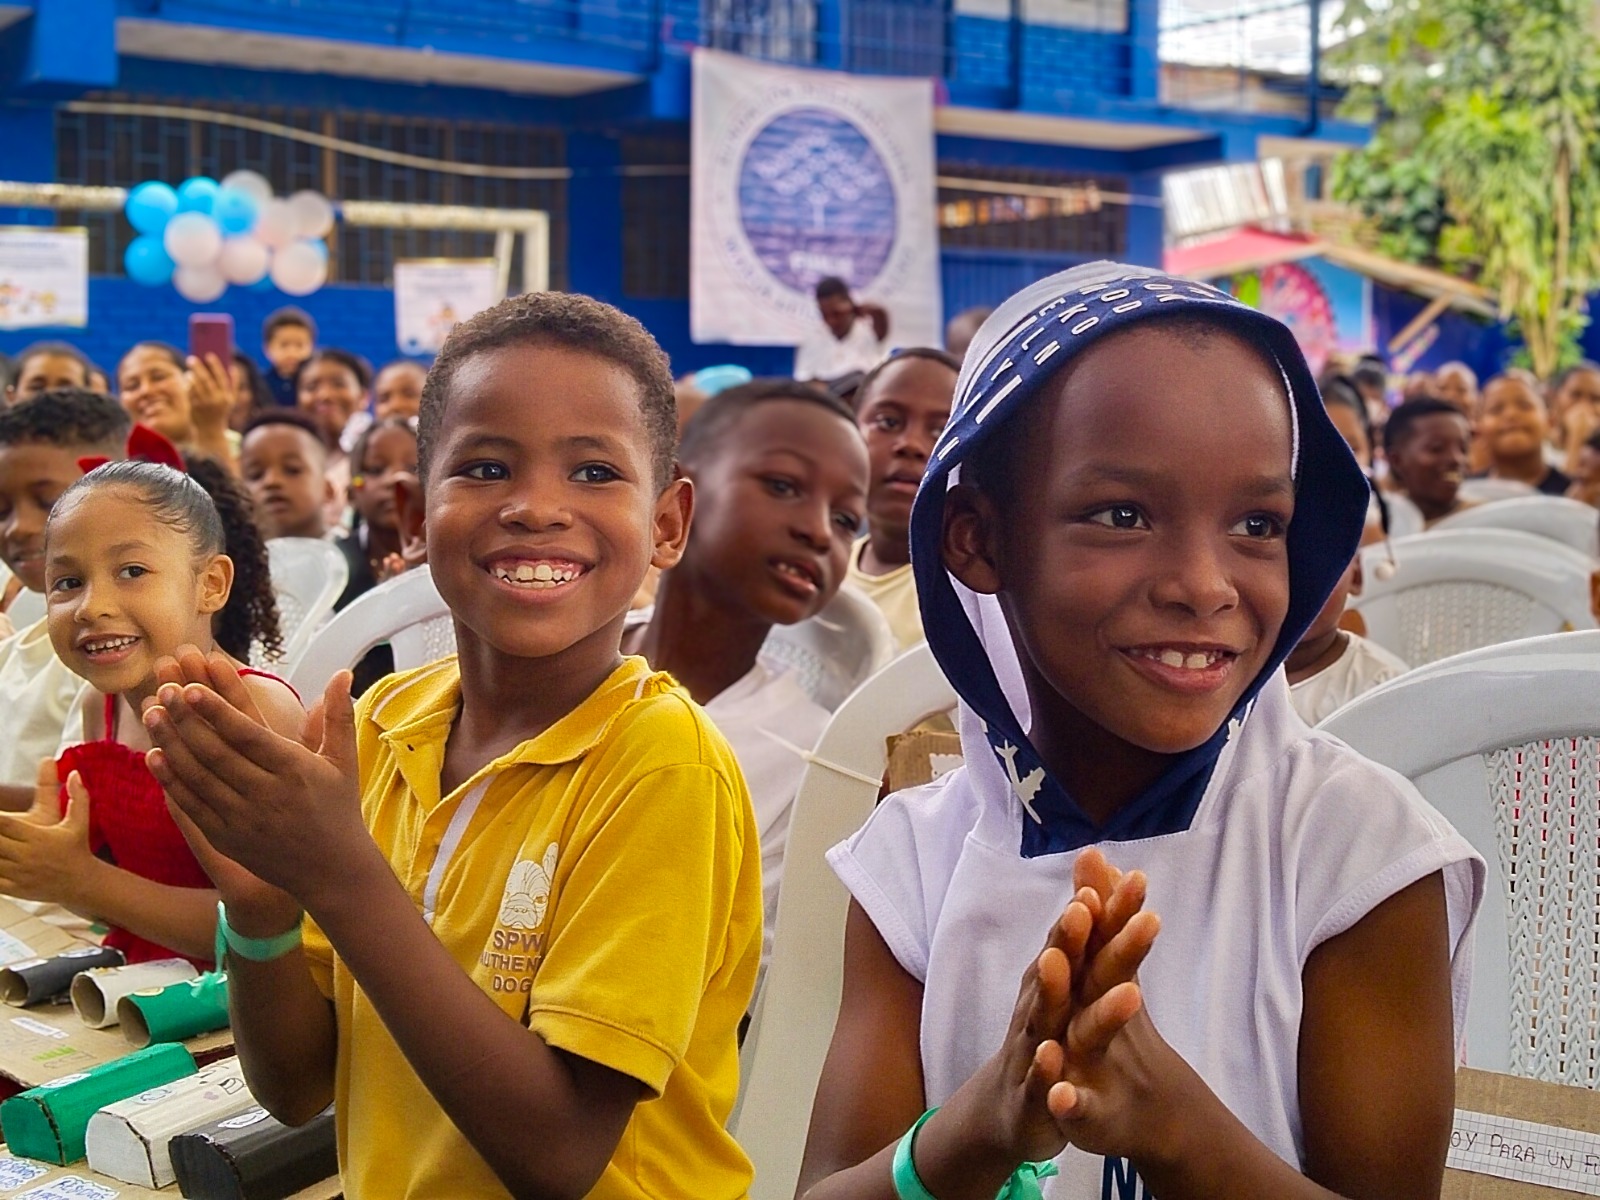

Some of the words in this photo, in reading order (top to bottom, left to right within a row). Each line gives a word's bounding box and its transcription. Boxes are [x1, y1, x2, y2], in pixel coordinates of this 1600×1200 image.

[493, 929, 544, 952] SPW
[481, 951, 541, 972] UTHEN
[1450, 1131, 1478, 1151] OY
[1488, 1133, 1536, 1163] PARA
[1548, 1149, 1573, 1170] UN
[1102, 1155, 1152, 1200] N
